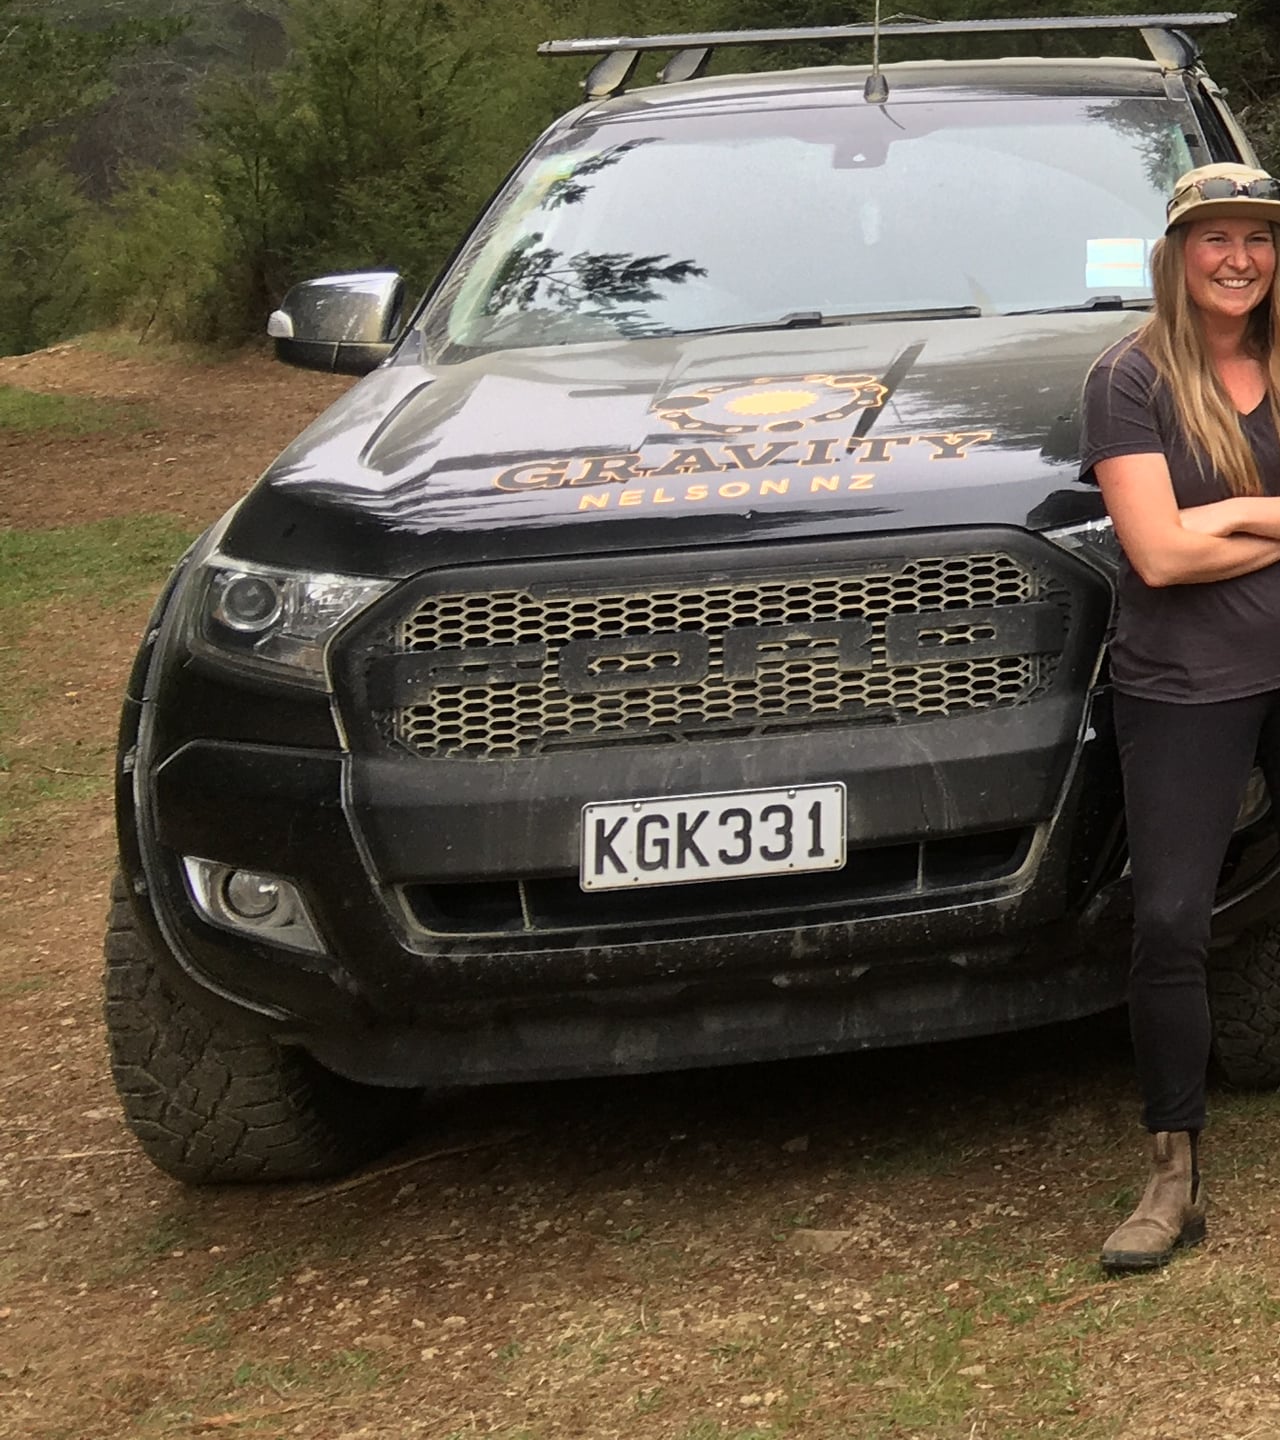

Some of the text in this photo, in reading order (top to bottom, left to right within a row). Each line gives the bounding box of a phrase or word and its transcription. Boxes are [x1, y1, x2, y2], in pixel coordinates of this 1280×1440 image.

[493, 431, 993, 491] GRAVITY
[578, 474, 876, 510] NELSON NZ
[595, 800, 827, 877] KGK331
